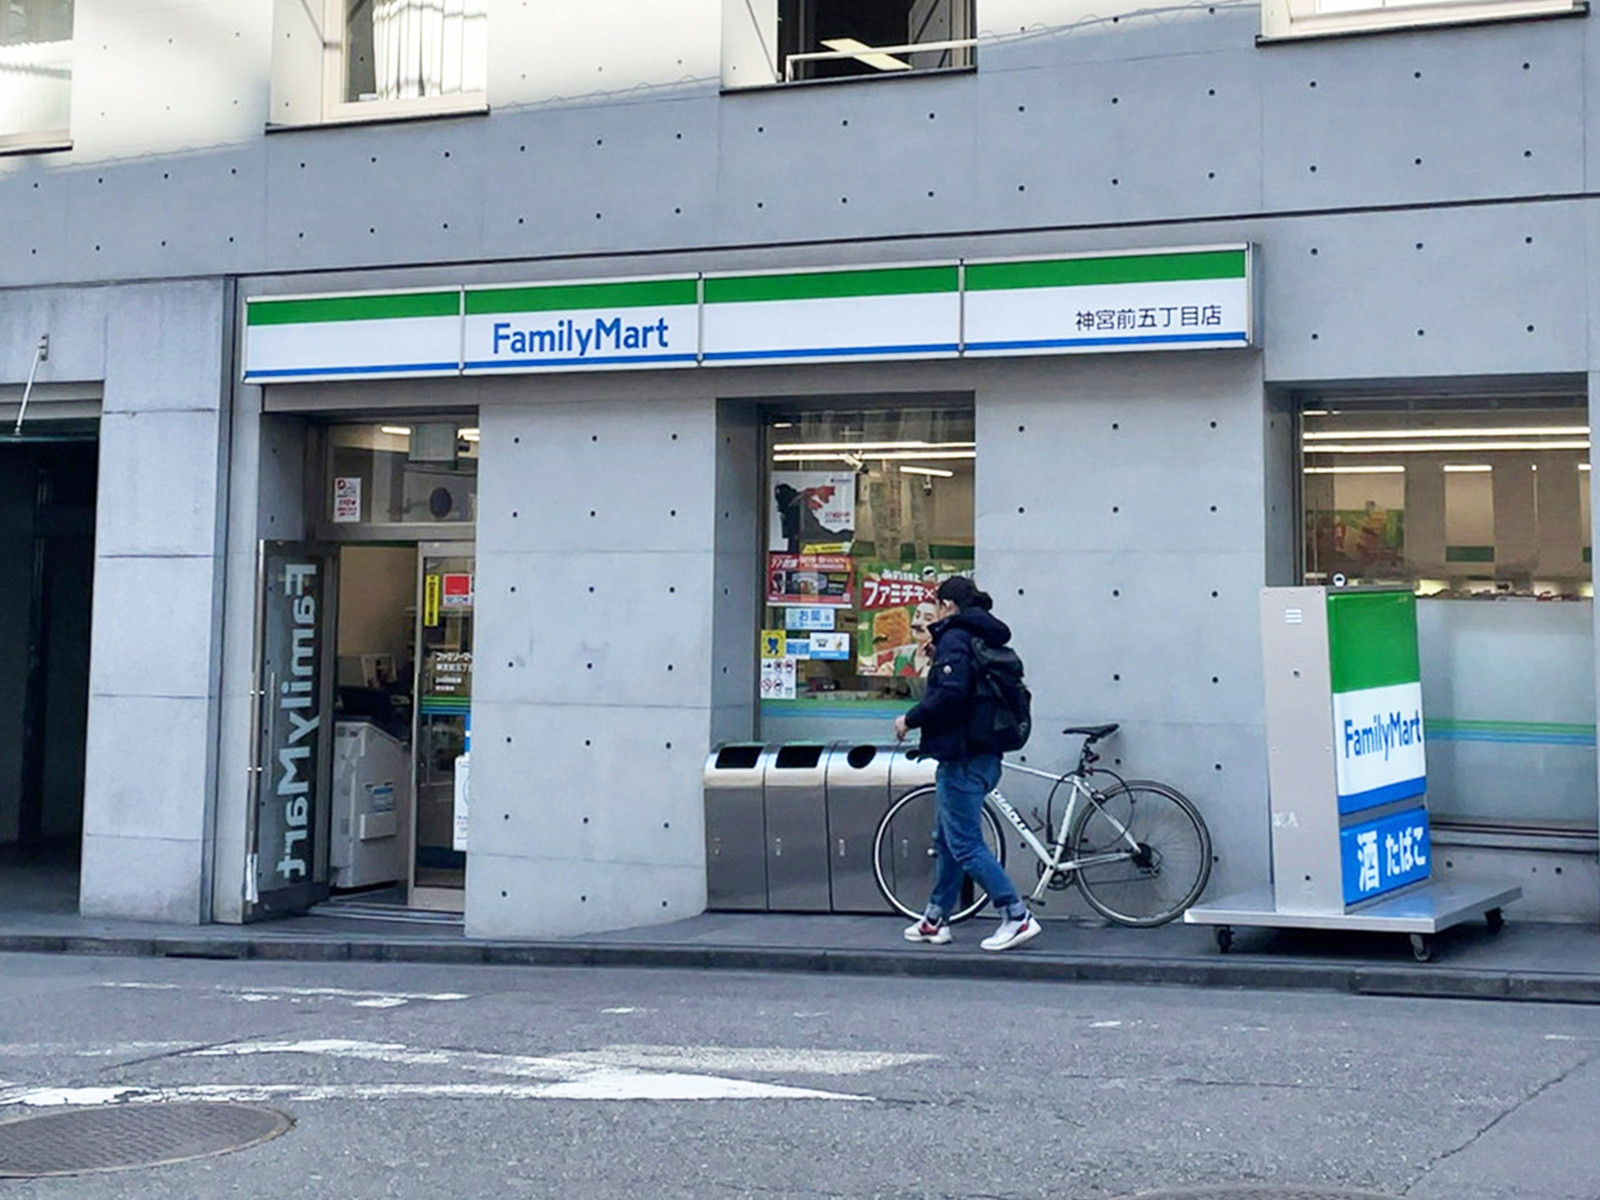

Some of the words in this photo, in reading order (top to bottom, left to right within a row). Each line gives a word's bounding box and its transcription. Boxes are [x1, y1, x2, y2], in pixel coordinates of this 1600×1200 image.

[493, 317, 668, 356] FamilyMart
[1075, 304, 1222, 332] 神宮前五丁目店
[863, 581, 938, 606] ファミチキ×
[1344, 711, 1421, 761] FamilyMart
[1357, 830, 1381, 892] 酒
[1385, 826, 1426, 877] たばこ
